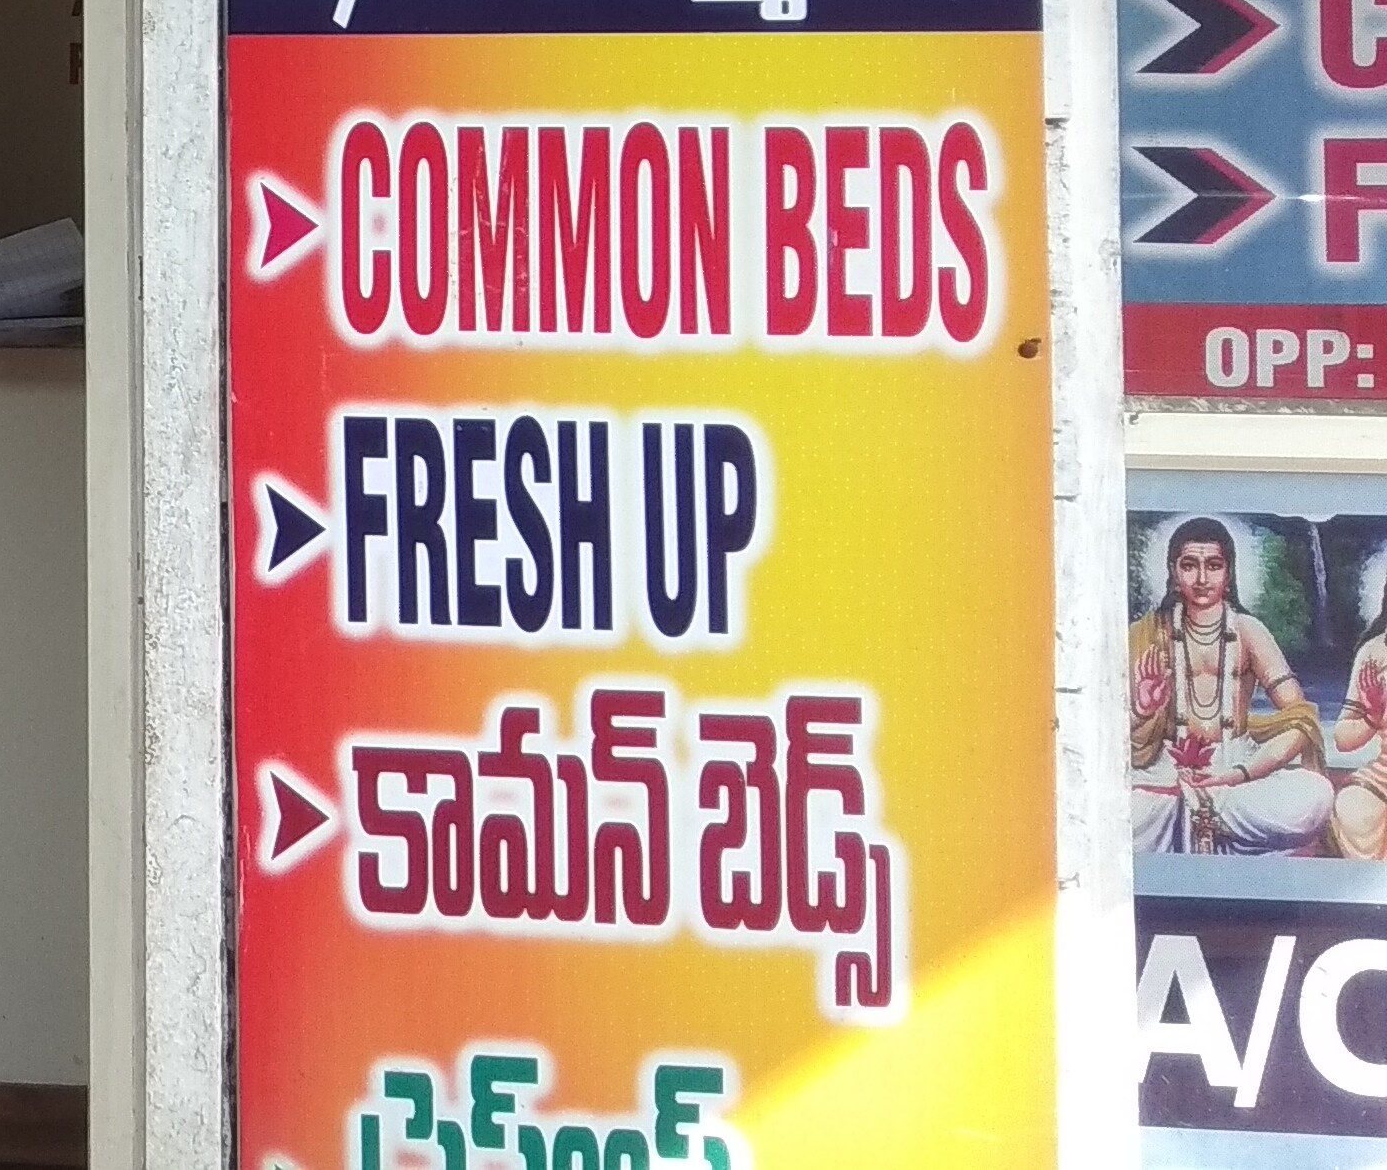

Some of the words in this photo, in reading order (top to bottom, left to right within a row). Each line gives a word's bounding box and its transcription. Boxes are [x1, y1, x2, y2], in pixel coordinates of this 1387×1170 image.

[339, 120, 732, 338] COMMON
[764, 120, 990, 343] BEDS
[1205, 325, 1375, 390] OPP:
[342, 415, 615, 634] FRESH
[641, 420, 758, 638] UP
[350, 688, 670, 926] కామన్
[1138, 933, 1387, 1109] A/C
